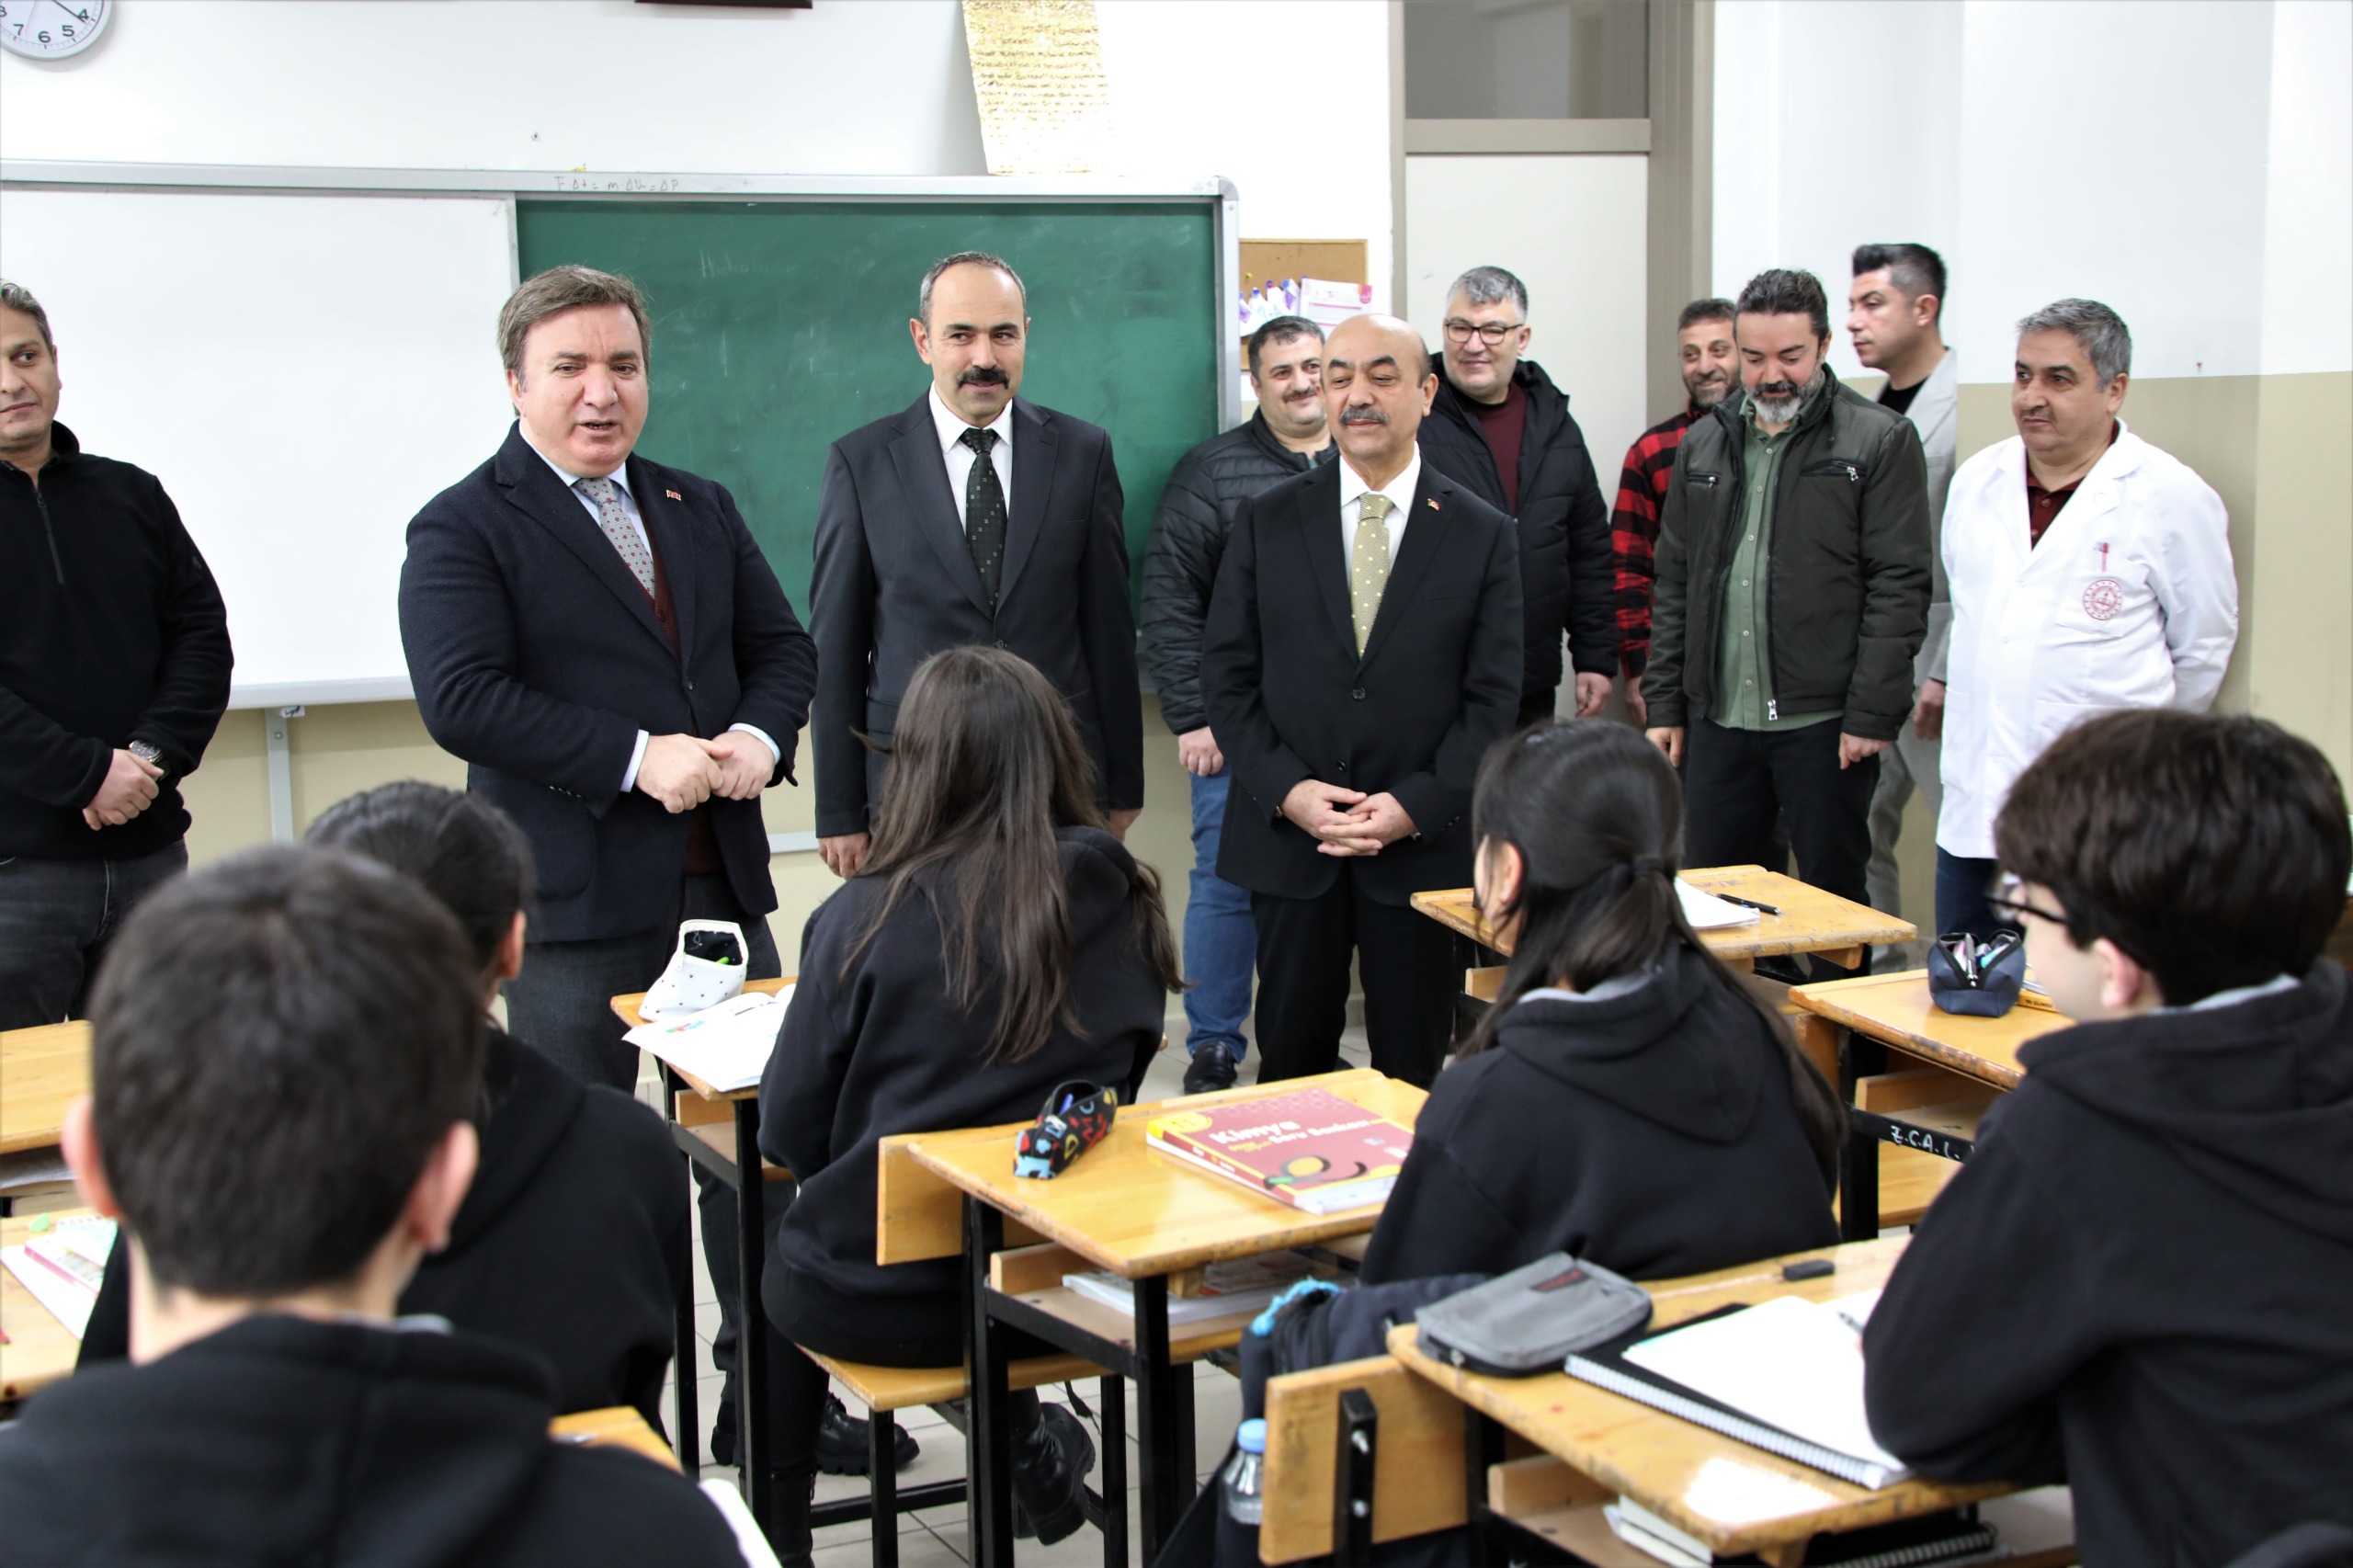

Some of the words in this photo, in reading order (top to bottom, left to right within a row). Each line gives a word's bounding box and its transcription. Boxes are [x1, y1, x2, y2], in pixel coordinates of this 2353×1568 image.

[77, 8, 89, 20] 4
[13, 24, 24, 36] 7
[62, 25, 74, 37] 5
[38, 30, 51, 43] 6
[1209, 1119, 1301, 1144] Kimya
[1268, 1131, 1308, 1144] Soru
